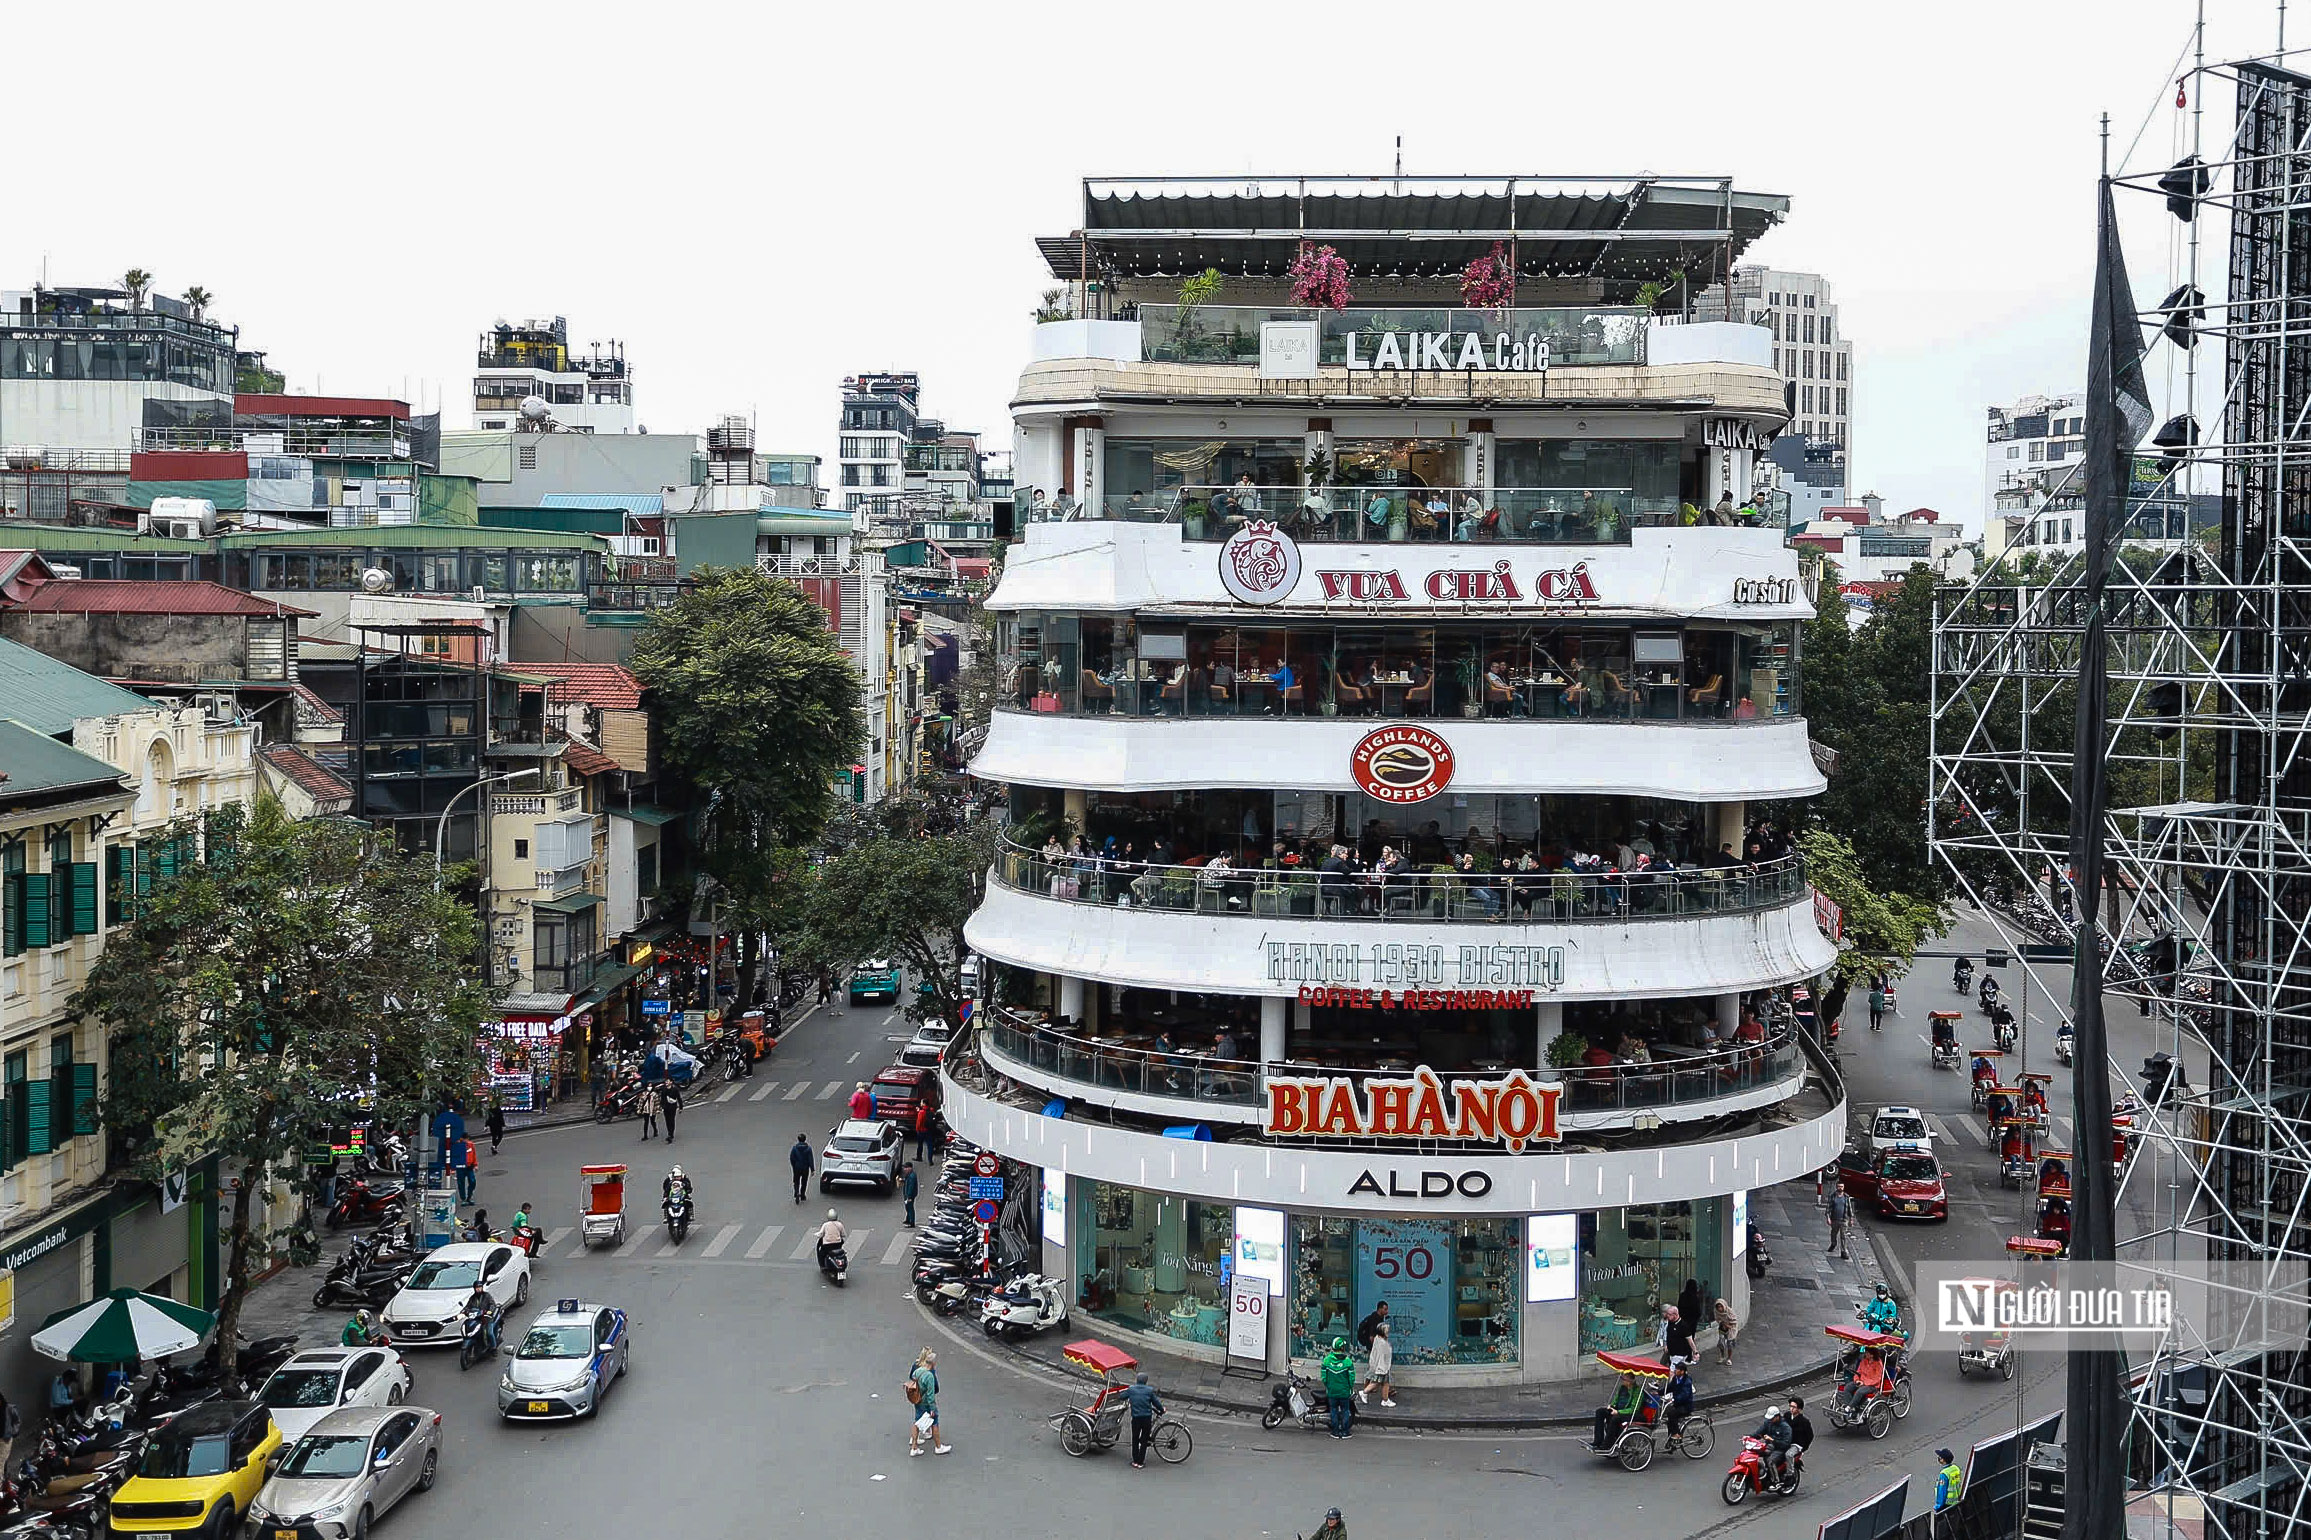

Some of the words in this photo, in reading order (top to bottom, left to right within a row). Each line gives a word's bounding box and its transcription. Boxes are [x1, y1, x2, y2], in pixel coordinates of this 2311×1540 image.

[1268, 338, 1309, 353] LAIKA
[1347, 332, 1488, 370] LAIKA
[1495, 332, 1551, 371] Café
[1703, 418, 1758, 449] LAIKA
[1316, 569, 1410, 602] VUA
[1424, 559, 1523, 602] CHẢ
[1536, 561, 1601, 602] CÁ
[1779, 578, 1798, 603] 10
[1356, 730, 1449, 763] HIGHLANDS
[1368, 780, 1439, 801] COFFEE
[1266, 942, 1360, 982] HANOI
[1372, 943, 1444, 984] 1930
[1458, 945, 1565, 986] BISTRO
[1298, 986, 1374, 1009] COFFEE
[1380, 989, 1396, 1009] &
[1403, 989, 1536, 1011] RESTAURANT
[507, 1021, 527, 1037] FREE
[528, 1021, 548, 1037] DATA
[1266, 1081, 1363, 1137] BIA
[1368, 1071, 1451, 1137] HÀ
[1455, 1074, 1562, 1152] NỘI
[1347, 1168, 1493, 1198] ALDO
[6, 1226, 68, 1270] Vietcombank
[1374, 1247, 1434, 1279] 50
[1183, 1253, 1214, 1278] Nắng
[1235, 1294, 1263, 1315] 50
